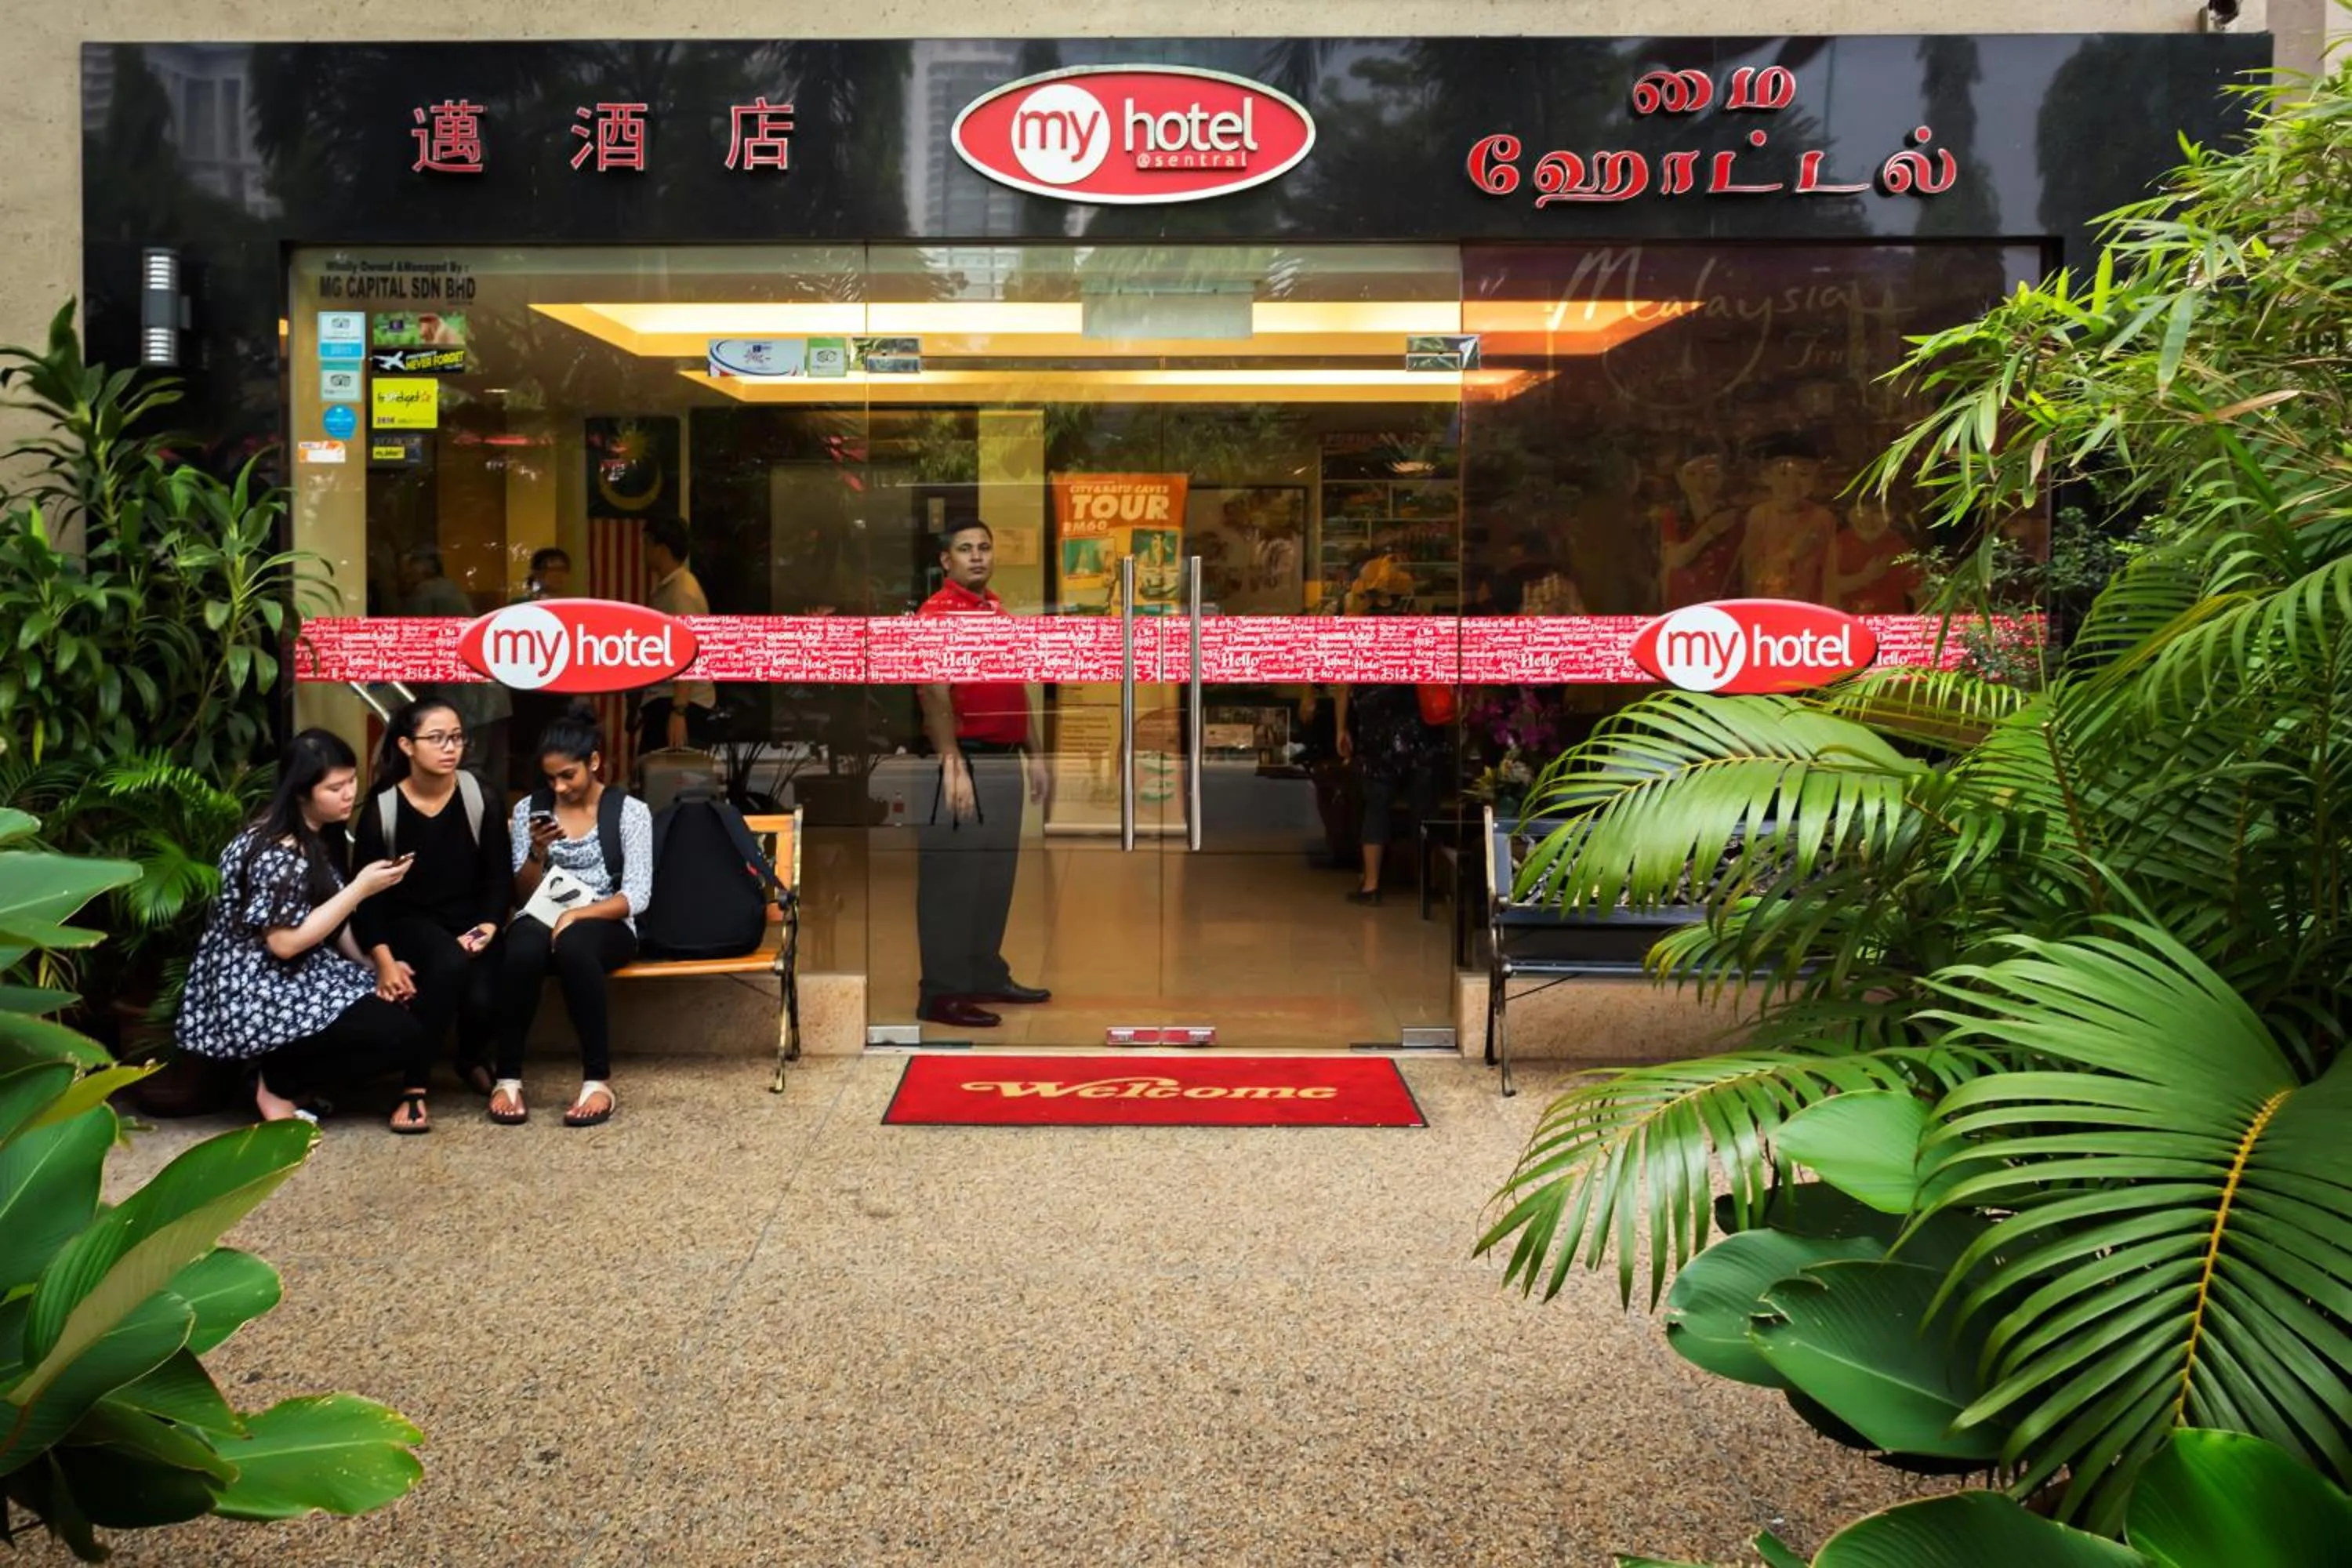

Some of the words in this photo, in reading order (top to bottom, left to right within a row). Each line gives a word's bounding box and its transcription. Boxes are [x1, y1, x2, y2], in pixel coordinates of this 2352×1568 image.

[1019, 109, 1100, 162] my
[1124, 97, 1258, 153] hotel
[1137, 152, 1247, 167] @sentral
[320, 277, 343, 298] MG
[347, 277, 407, 299] CAPITAL
[411, 277, 441, 299] SDN
[445, 277, 476, 299] BHD
[1072, 495, 1170, 521] TOUR
[1063, 520, 1108, 532] RM60
[493, 625, 567, 677] my
[576, 622, 675, 667] hotel
[942, 653, 980, 666] Hello
[1221, 653, 1260, 667] Hello
[1521, 652, 1559, 667] Hello
[1668, 630, 1739, 679] my
[1753, 623, 1853, 667] hotel
[962, 1076, 1338, 1099] Welcome
